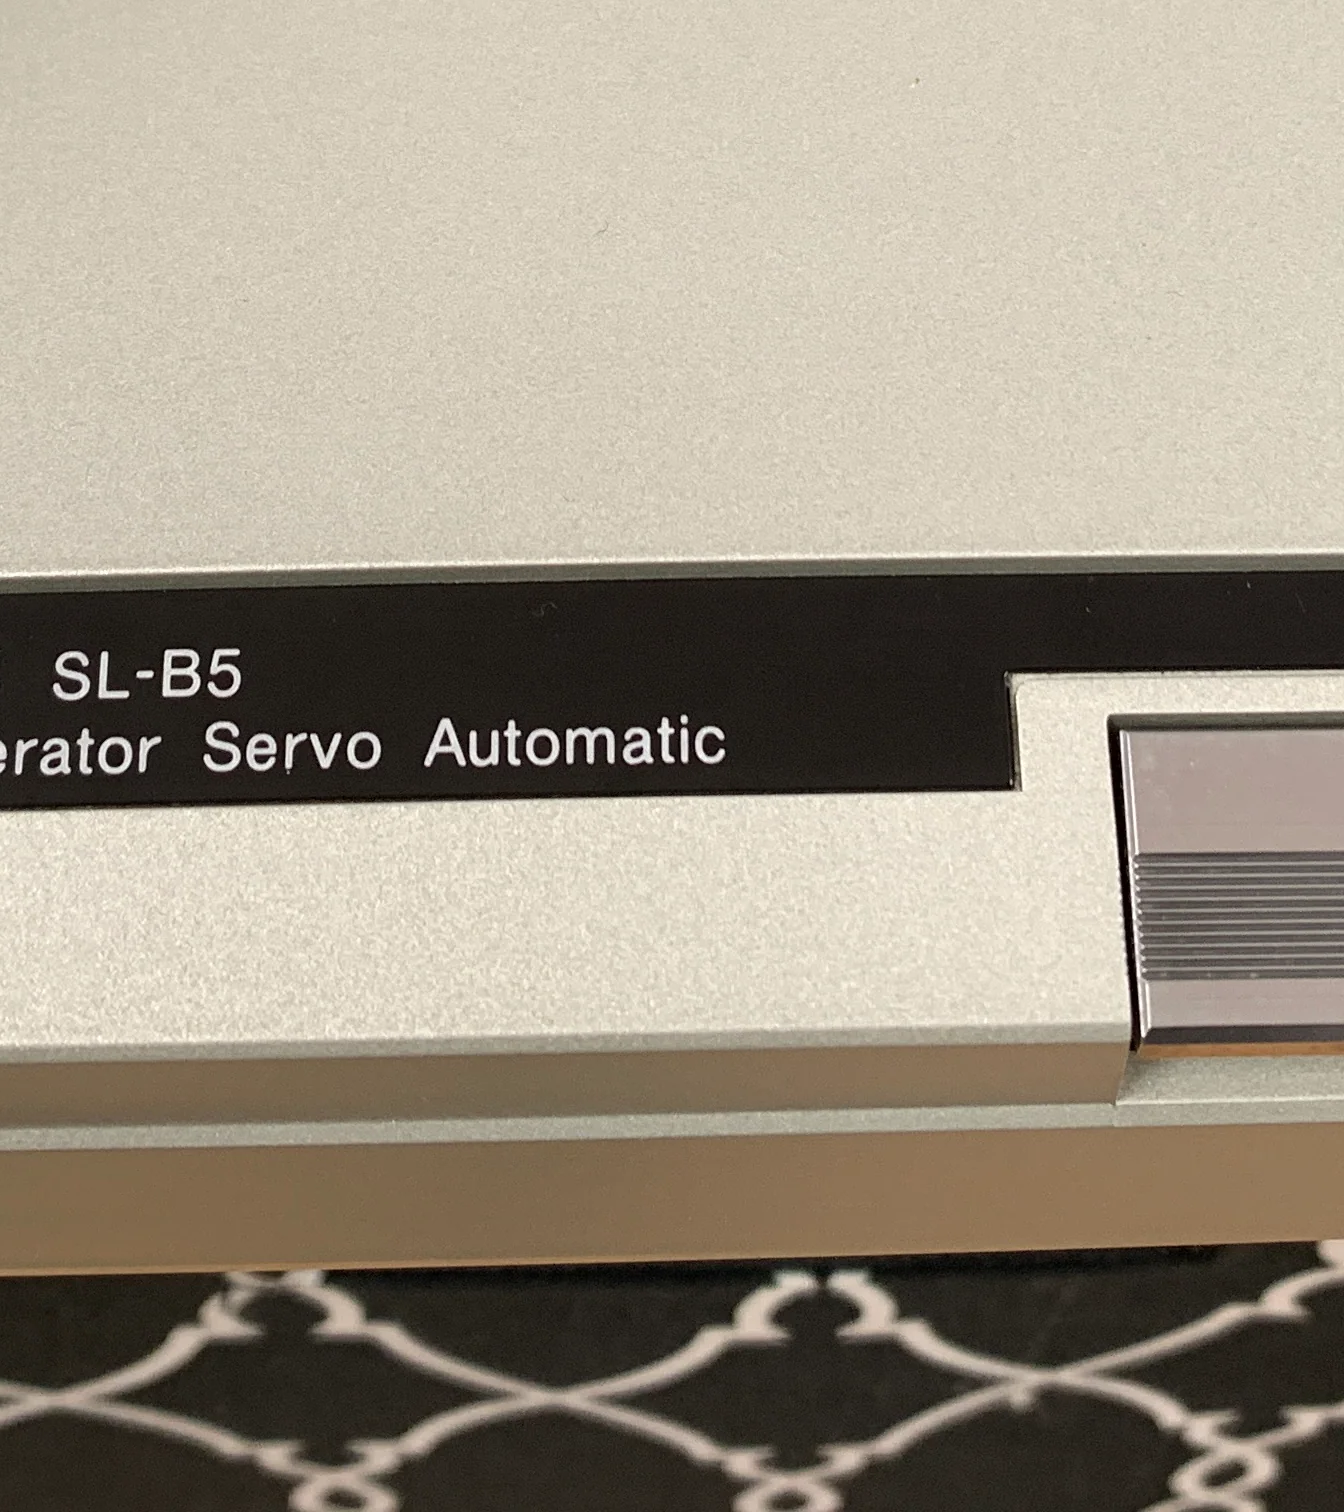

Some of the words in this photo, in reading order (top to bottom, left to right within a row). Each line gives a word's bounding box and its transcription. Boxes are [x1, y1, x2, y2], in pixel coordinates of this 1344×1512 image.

[52, 648, 243, 702] SL-B5
[202, 720, 382, 775] Servo
[423, 714, 727, 768] Automatic
